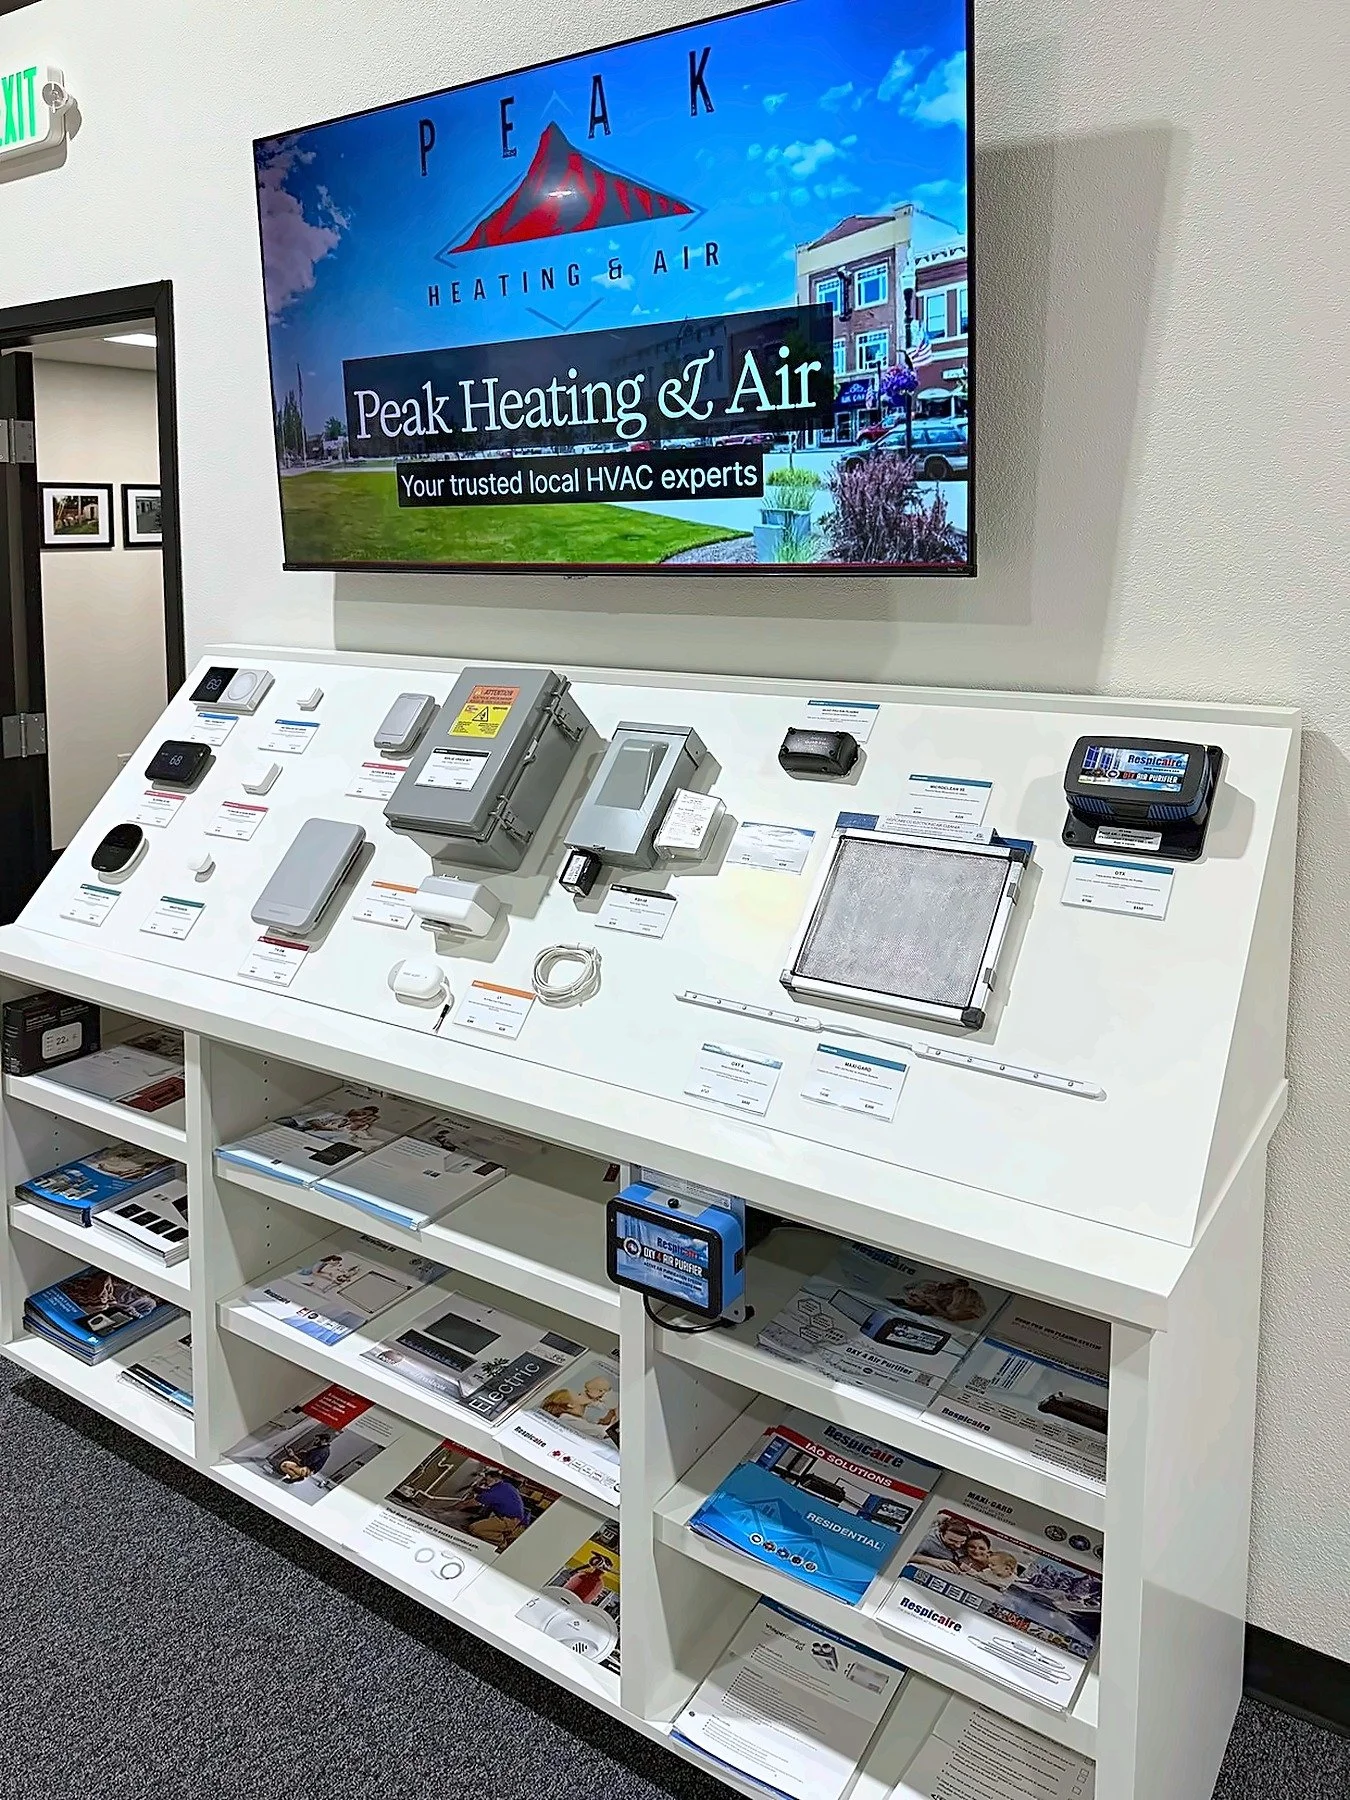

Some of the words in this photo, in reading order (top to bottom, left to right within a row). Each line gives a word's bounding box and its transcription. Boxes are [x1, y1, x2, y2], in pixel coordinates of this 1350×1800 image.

[0, 66, 37, 147] XIT
[418, 46, 715, 177] PEAK
[428, 263, 580, 307] HEATING
[608, 257, 623, 280] &
[652, 241, 720, 275] AIR
[353, 380, 453, 440] Peak
[458, 367, 648, 440] Heating
[658, 348, 715, 421] &
[724, 345, 822, 415] Air
[401, 474, 445, 497] Your
[449, 470, 522, 496] trusted
[529, 467, 580, 494] local
[586, 464, 654, 492] HVAC
[661, 461, 758, 495] experts
[169, 755, 184, 766] 68
[1127, 754, 1183, 768] Respicaire
[1148, 774, 1179, 784] PURIFIER
[643, 1246, 656, 1260] OXY
[656, 1252, 663, 1262] 4
[662, 1253, 674, 1267] AIR
[674, 1257, 704, 1278] PURIFIER
[845, 1347, 862, 1356] OXY
[868, 1355, 881, 1364] Air
[881, 1359, 914, 1375] Purifier
[471, 1362, 540, 1412] Electric
[513, 1425, 547, 1449] Respicaire
[941, 1406, 992, 1433] Respicaire
[804, 1442, 826, 1458] IAQ
[826, 1453, 893, 1489] SOLUTIONS
[823, 1424, 905, 1470] Respicaire
[806, 1512, 882, 1551] RESIDENTIAL
[900, 1596, 963, 1633] Respicaire
